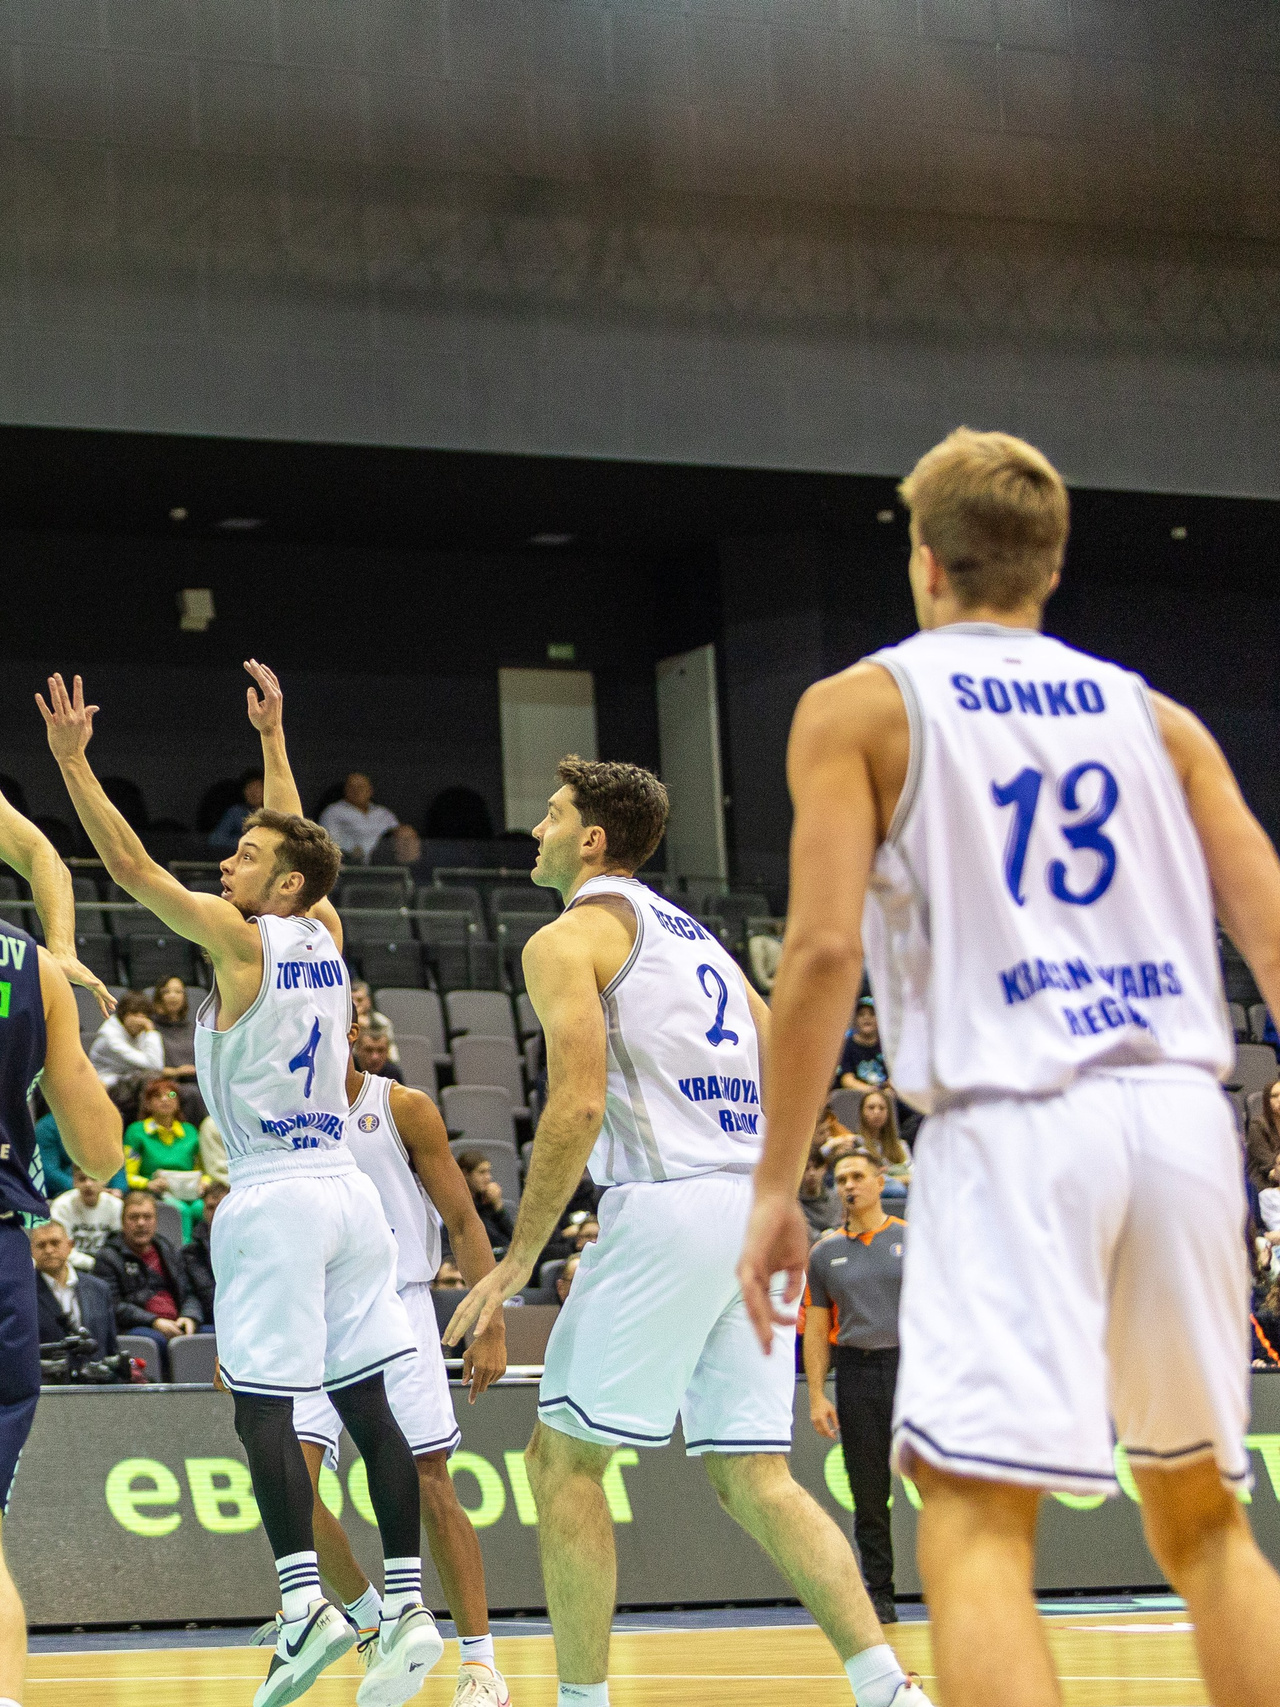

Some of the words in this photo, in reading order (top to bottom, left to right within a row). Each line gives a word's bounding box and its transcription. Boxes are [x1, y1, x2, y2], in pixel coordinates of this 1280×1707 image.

[950, 672, 1106, 716] SONKO
[990, 761, 1119, 907] 13
[696, 963, 739, 1047] 2
